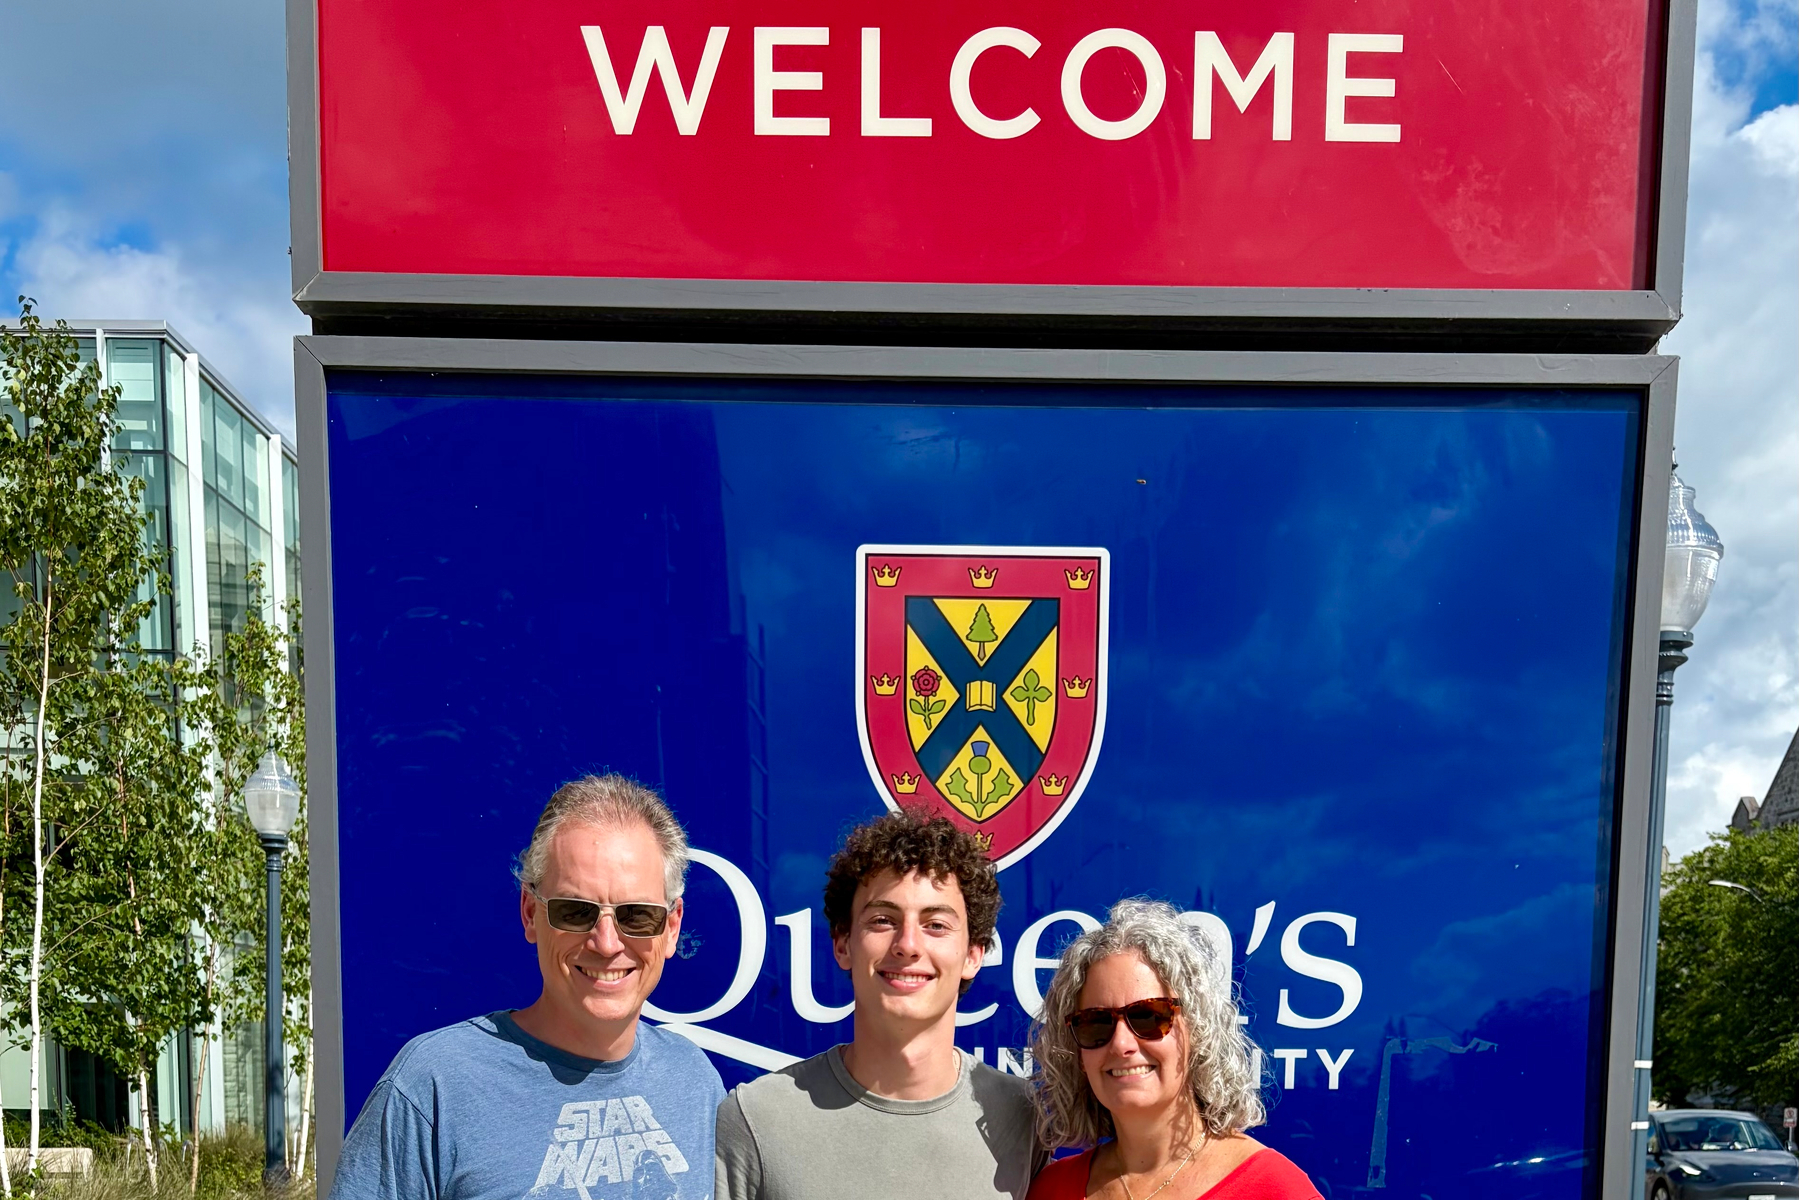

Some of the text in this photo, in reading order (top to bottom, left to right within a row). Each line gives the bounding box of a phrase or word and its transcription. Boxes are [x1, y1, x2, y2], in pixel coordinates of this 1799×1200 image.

[580, 26, 1404, 143] WELCOME
[640, 848, 1364, 1075] Que's
[533, 1129, 690, 1189] WARS
[553, 1095, 663, 1142] STAR
